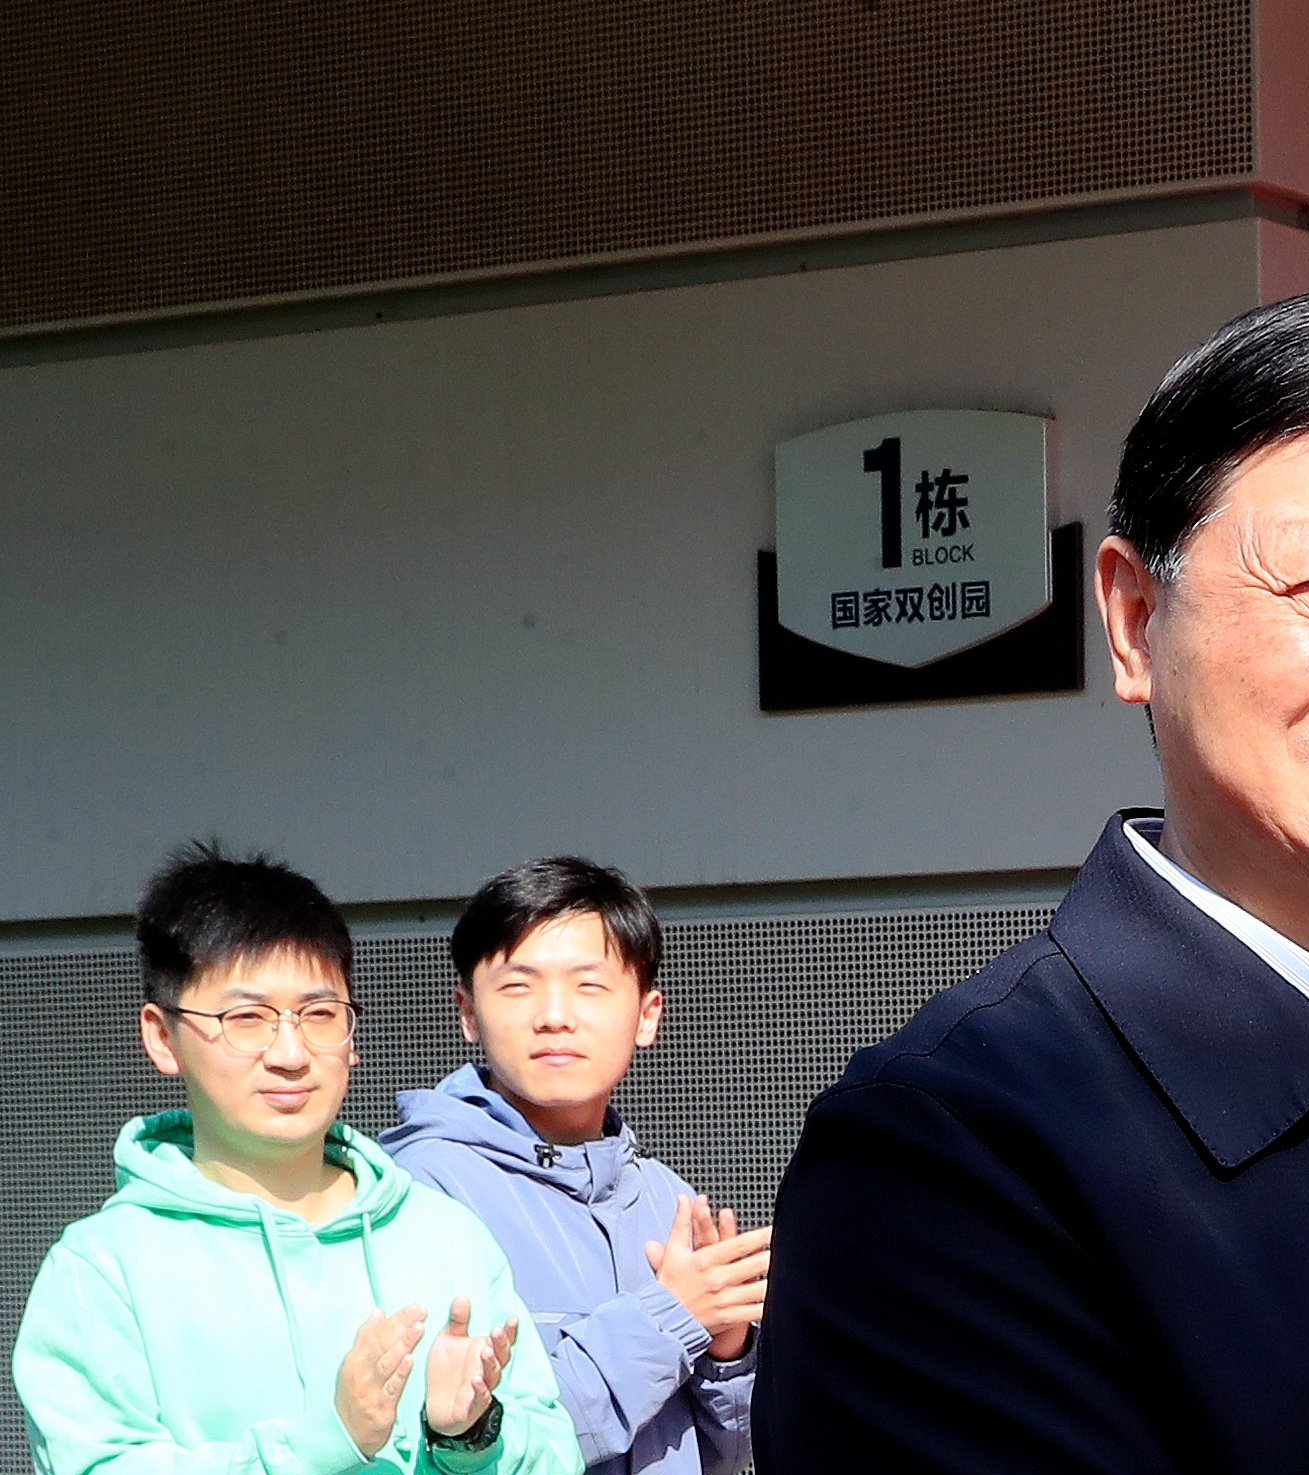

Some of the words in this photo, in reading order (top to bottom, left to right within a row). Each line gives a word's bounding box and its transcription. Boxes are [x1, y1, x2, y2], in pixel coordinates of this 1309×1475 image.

[863, 437, 970, 569] 1栋
[911, 543, 975, 567] BLOCK
[830, 579, 991, 631] 国家双创园
